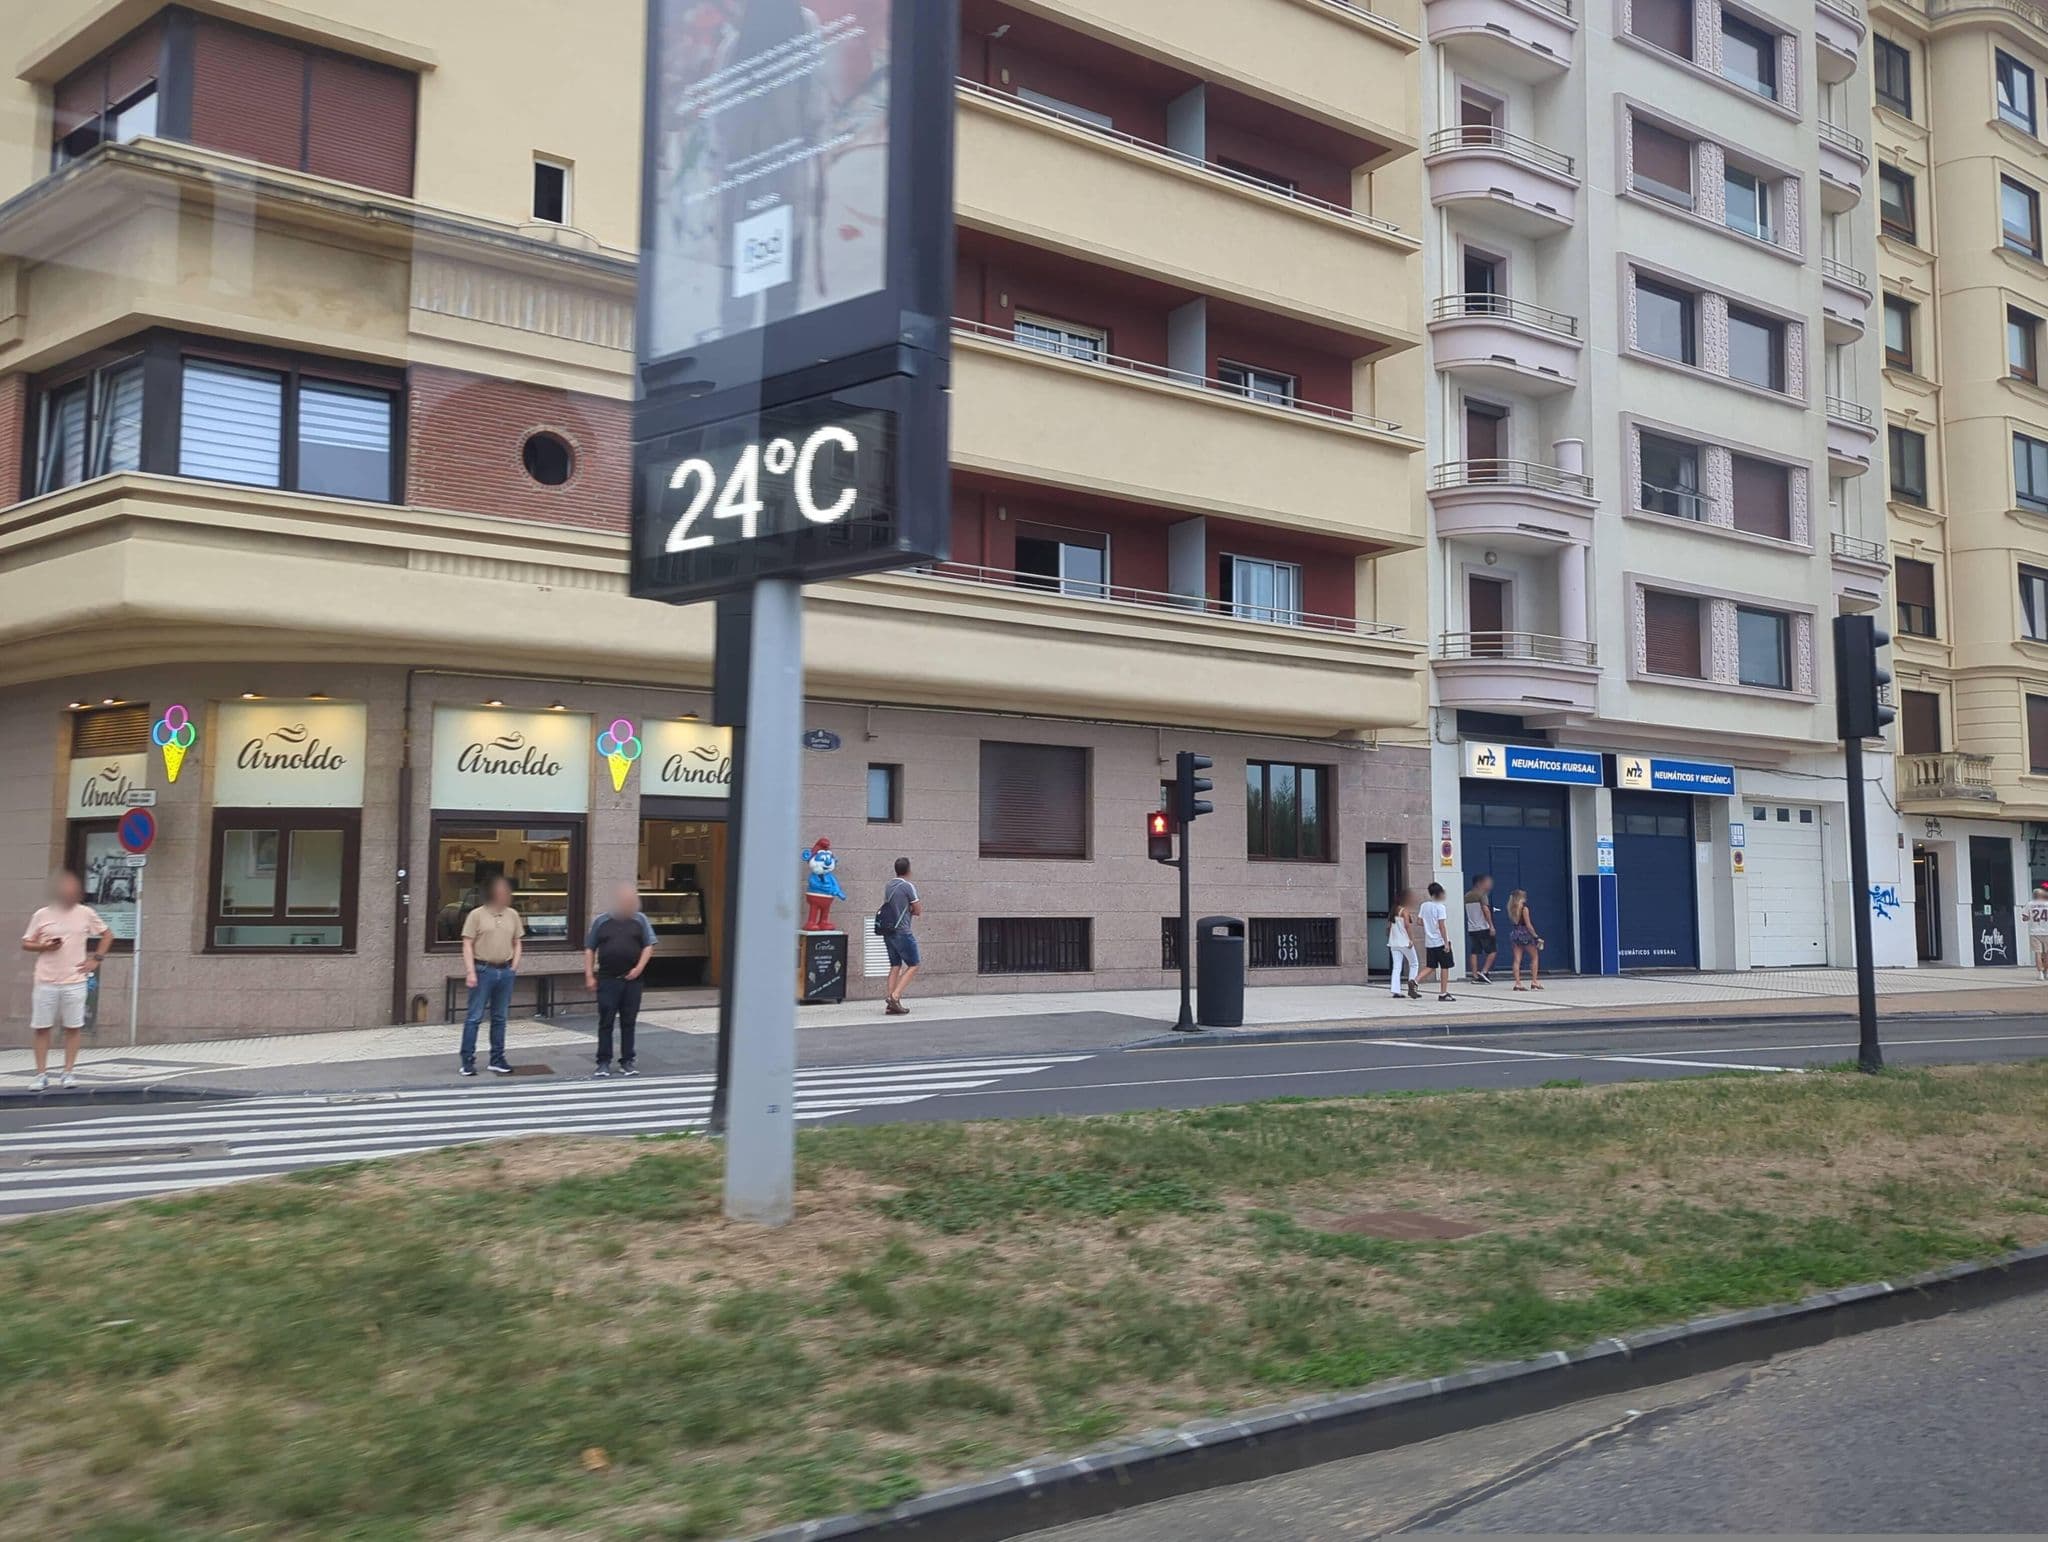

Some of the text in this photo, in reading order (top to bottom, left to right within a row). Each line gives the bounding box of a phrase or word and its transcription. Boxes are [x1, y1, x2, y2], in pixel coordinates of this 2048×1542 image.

[237, 738, 347, 770] Arnoldo
[457, 743, 562, 776] Arnoldo
[1511, 758, 1597, 774] NEUMÁTICOS KURSAAL
[1654, 770, 1695, 782] NEUMÁTICOS
[1695, 774, 1701, 782] Y
[1700, 773, 1732, 785] MECÁNICA
